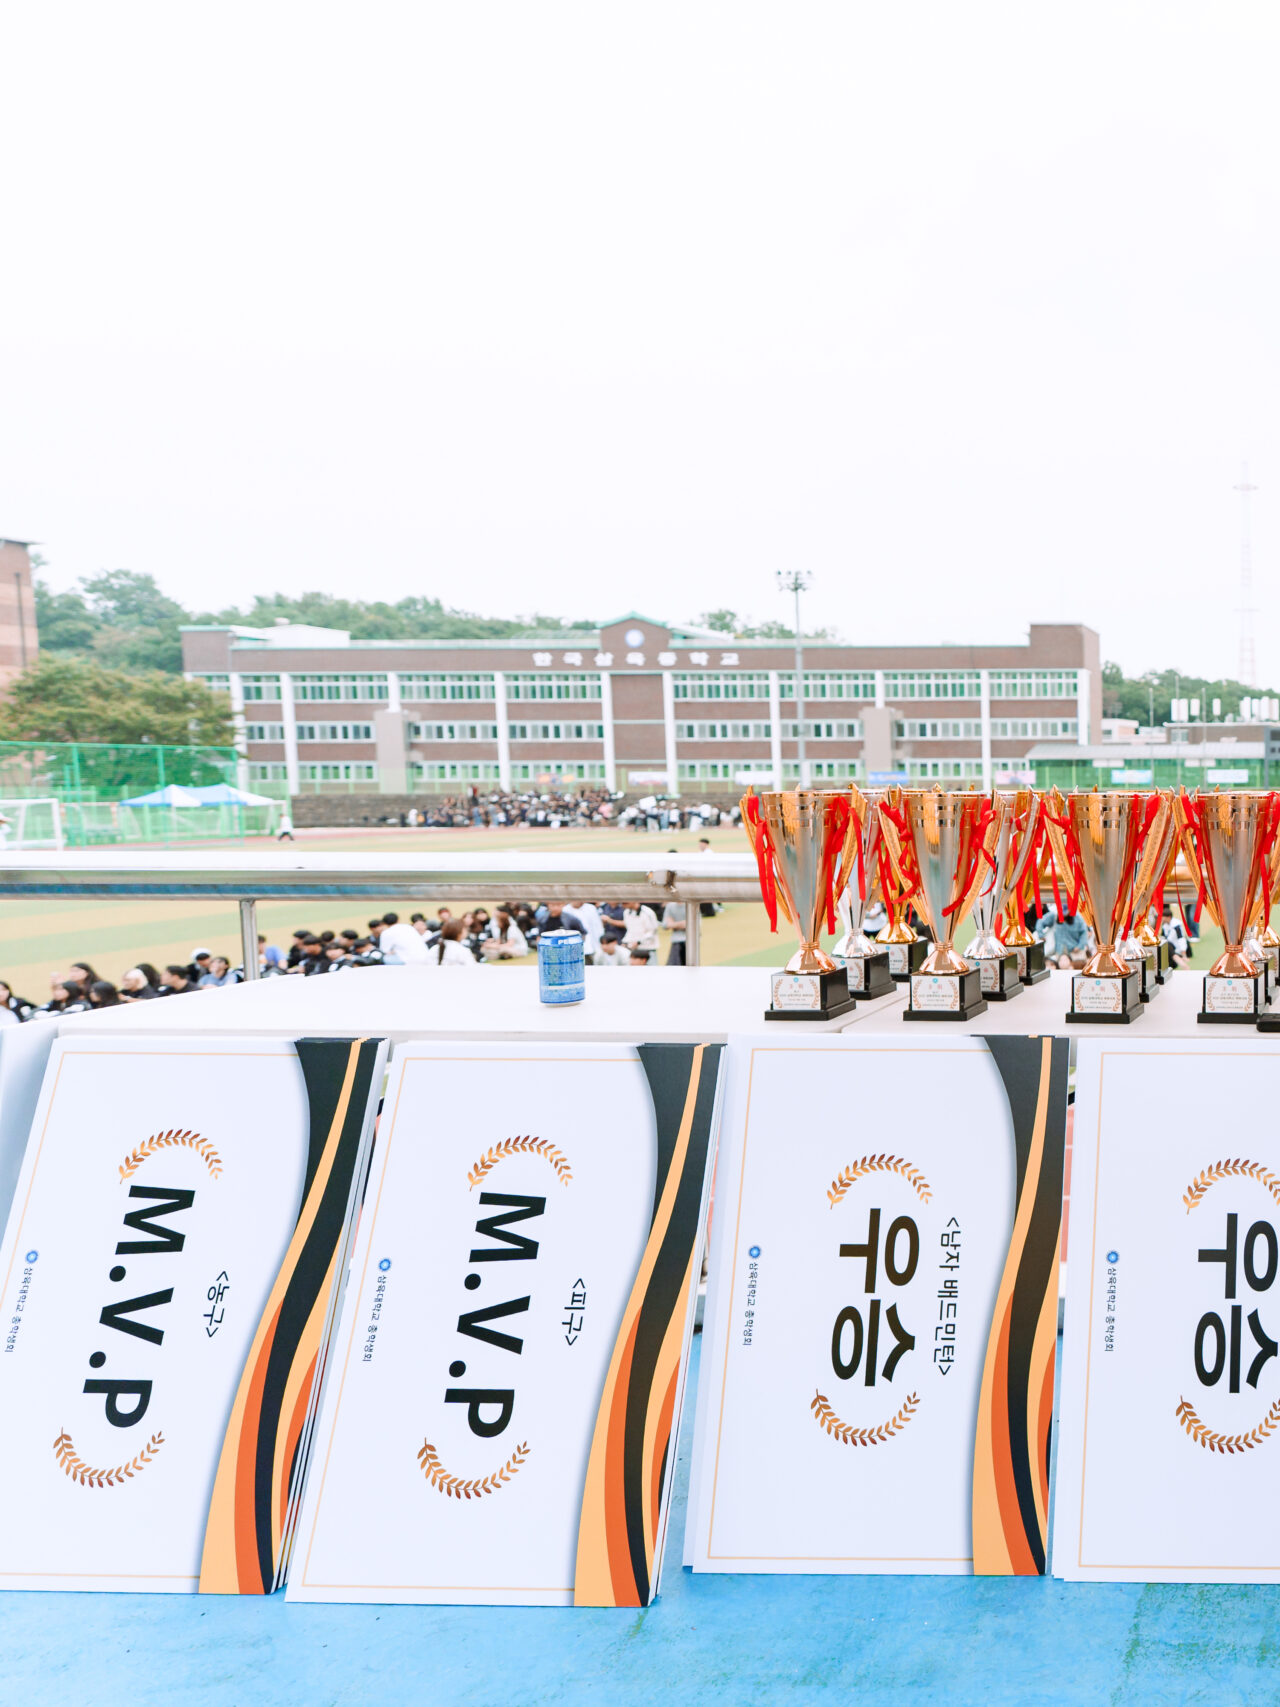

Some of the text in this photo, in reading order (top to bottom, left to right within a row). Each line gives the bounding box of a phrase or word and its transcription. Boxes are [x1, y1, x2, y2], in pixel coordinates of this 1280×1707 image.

[4, 1267, 34, 1352] 삼육대학교 총학생회
[82, 1185, 196, 1428] M.V.P
[203, 1271, 230, 1338] <농구>
[361, 1275, 388, 1361] 삼육대학교 총학생회
[444, 1192, 546, 1438] M.V.P
[562, 1278, 586, 1346] <피구>
[741, 1262, 759, 1345] 삼육대학교 총학생회
[831, 1208, 919, 1387] 우승
[934, 1217, 961, 1375] <남자 배드민턴>
[1103, 1266, 1118, 1351] 삼육대학교 총학생회
[1194, 1213, 1279, 1393] 우승
